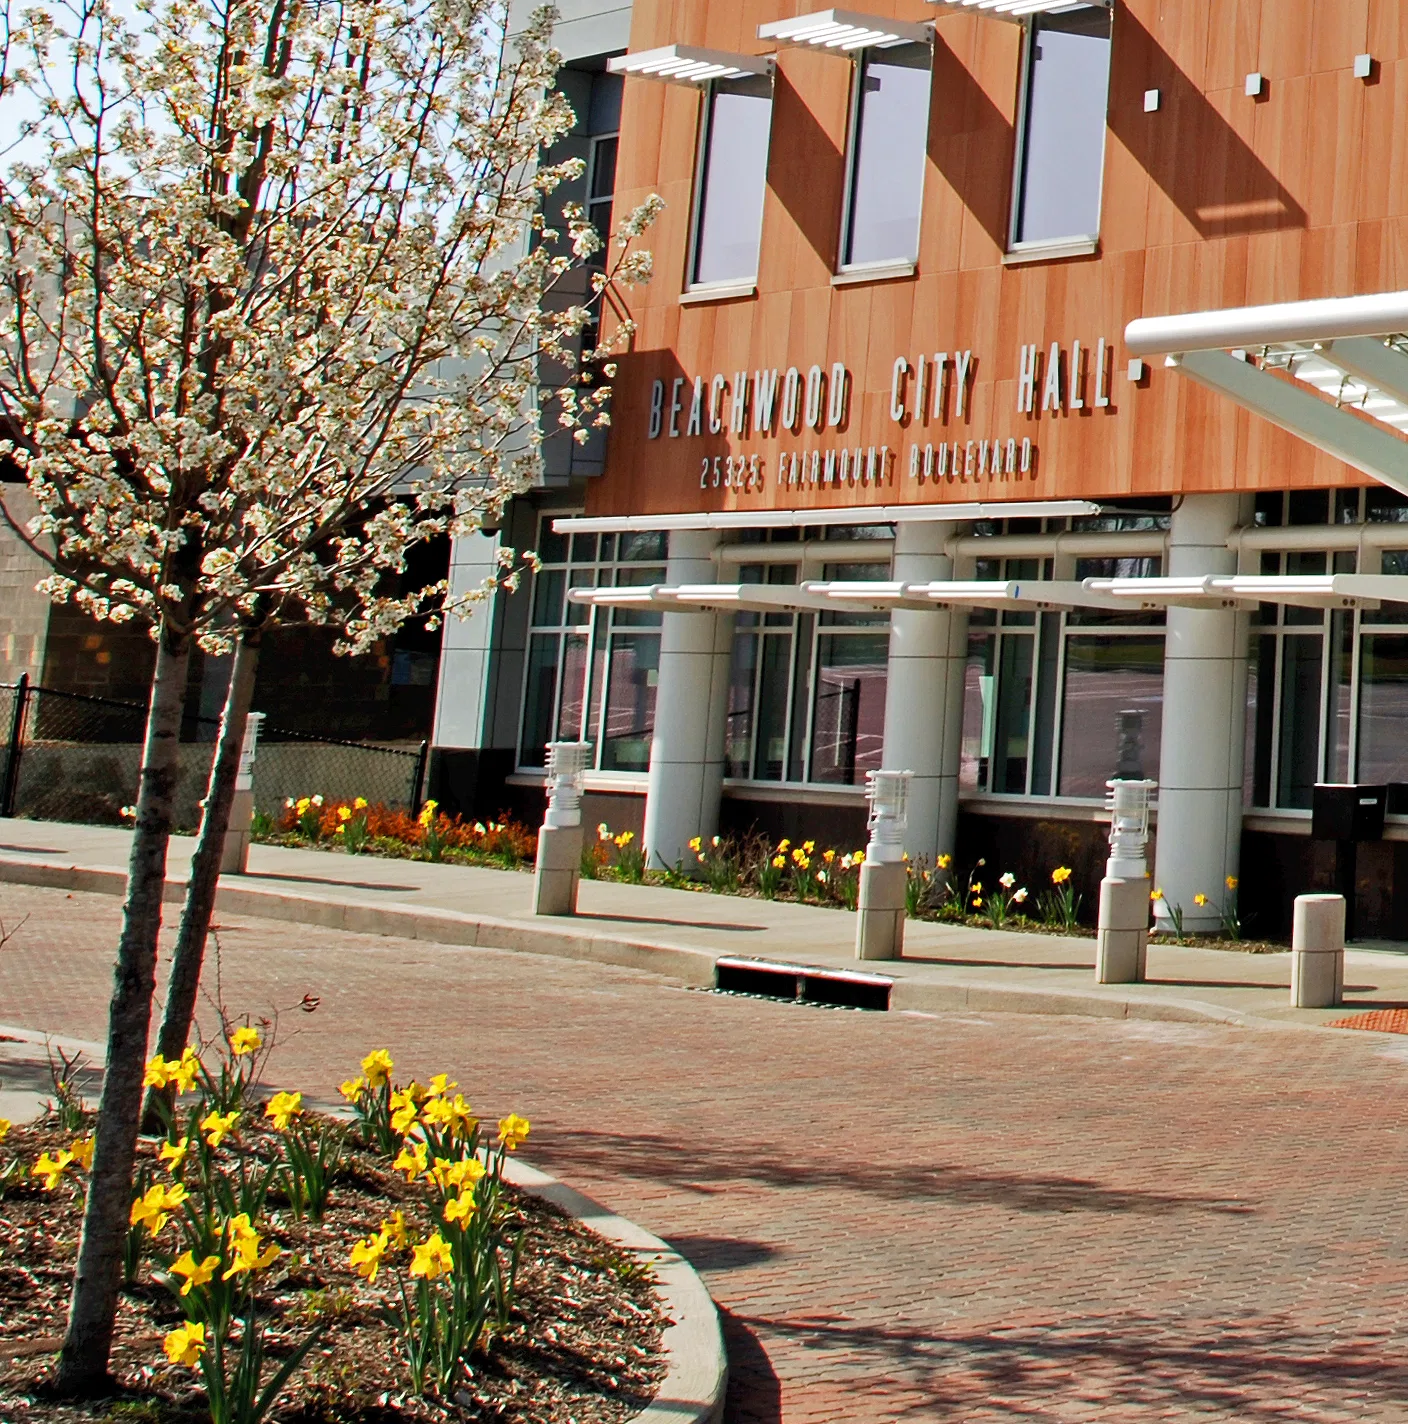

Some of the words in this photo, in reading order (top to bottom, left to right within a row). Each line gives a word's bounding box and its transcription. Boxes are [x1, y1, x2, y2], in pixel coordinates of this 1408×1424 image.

[648, 362, 846, 439] BEACHWOOD
[890, 349, 973, 421] CITY
[1017, 336, 1109, 413] HALL
[700, 453, 759, 489] 25325
[778, 445, 888, 485] FAIRMOUNT
[909, 436, 1031, 478] BOULEVARD
